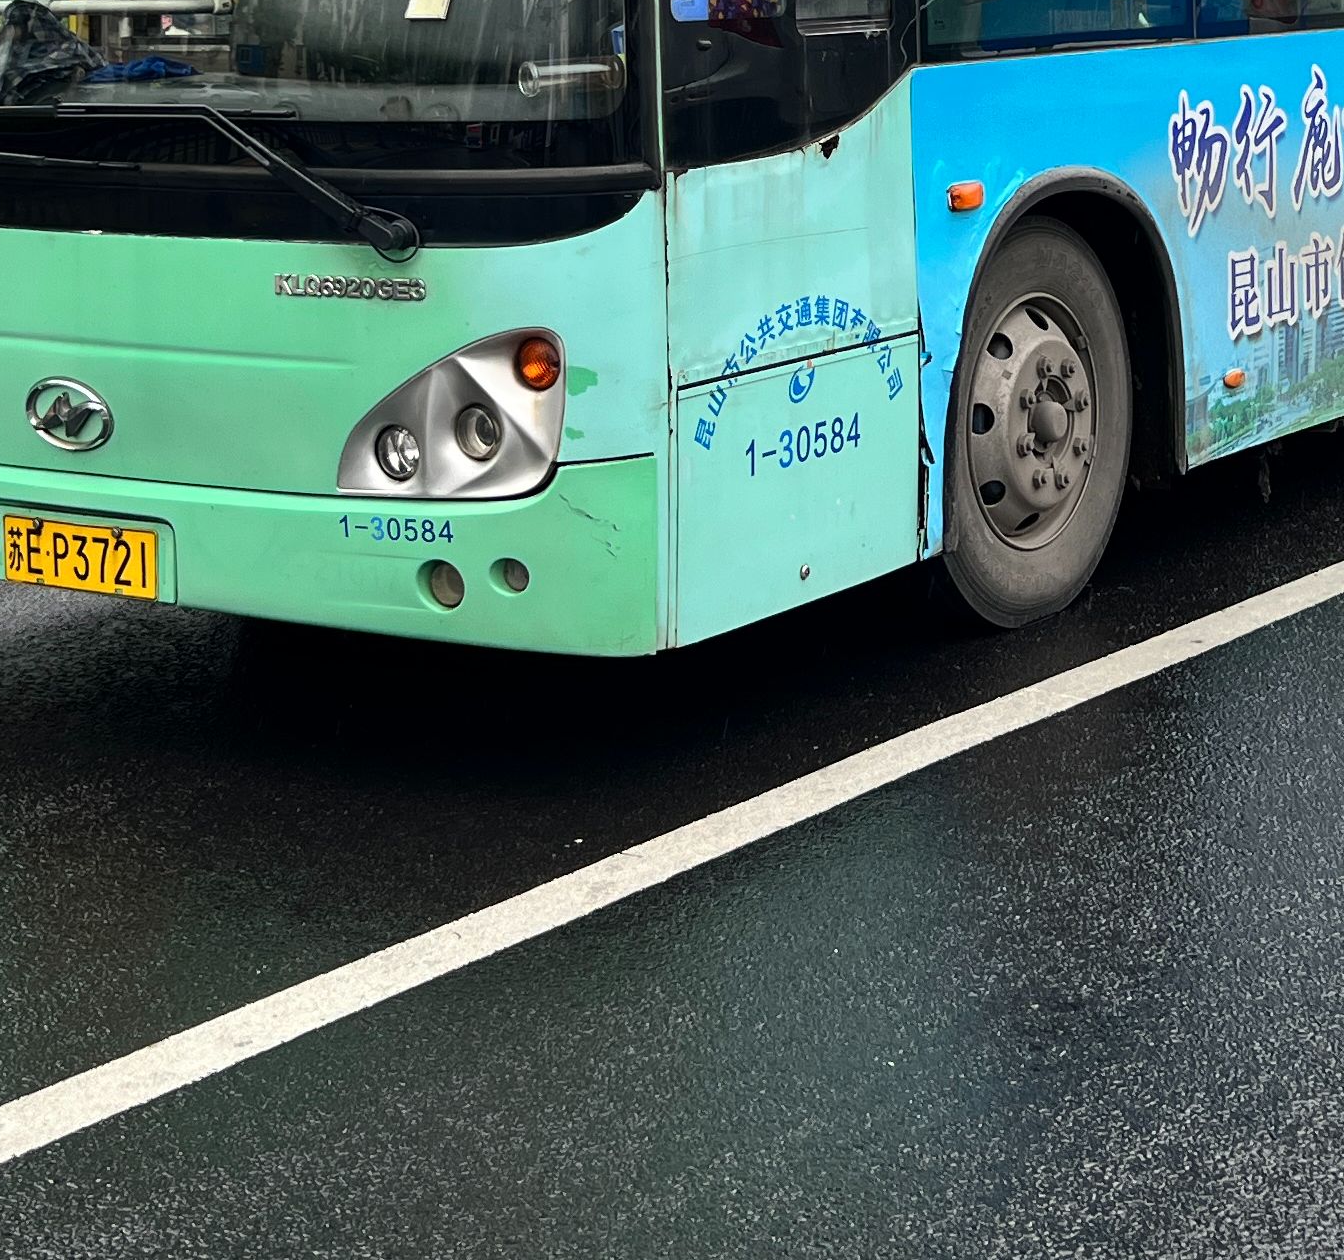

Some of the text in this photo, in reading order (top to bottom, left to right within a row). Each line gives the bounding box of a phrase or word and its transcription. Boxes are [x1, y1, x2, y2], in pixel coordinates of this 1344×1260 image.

[274, 273, 426, 301] KLQ6920GE3
[694, 295, 904, 450] 昆山市公共交通集团有限公司
[745, 412, 861, 476] 1-30584
[339, 514, 454, 543] 1-30584
